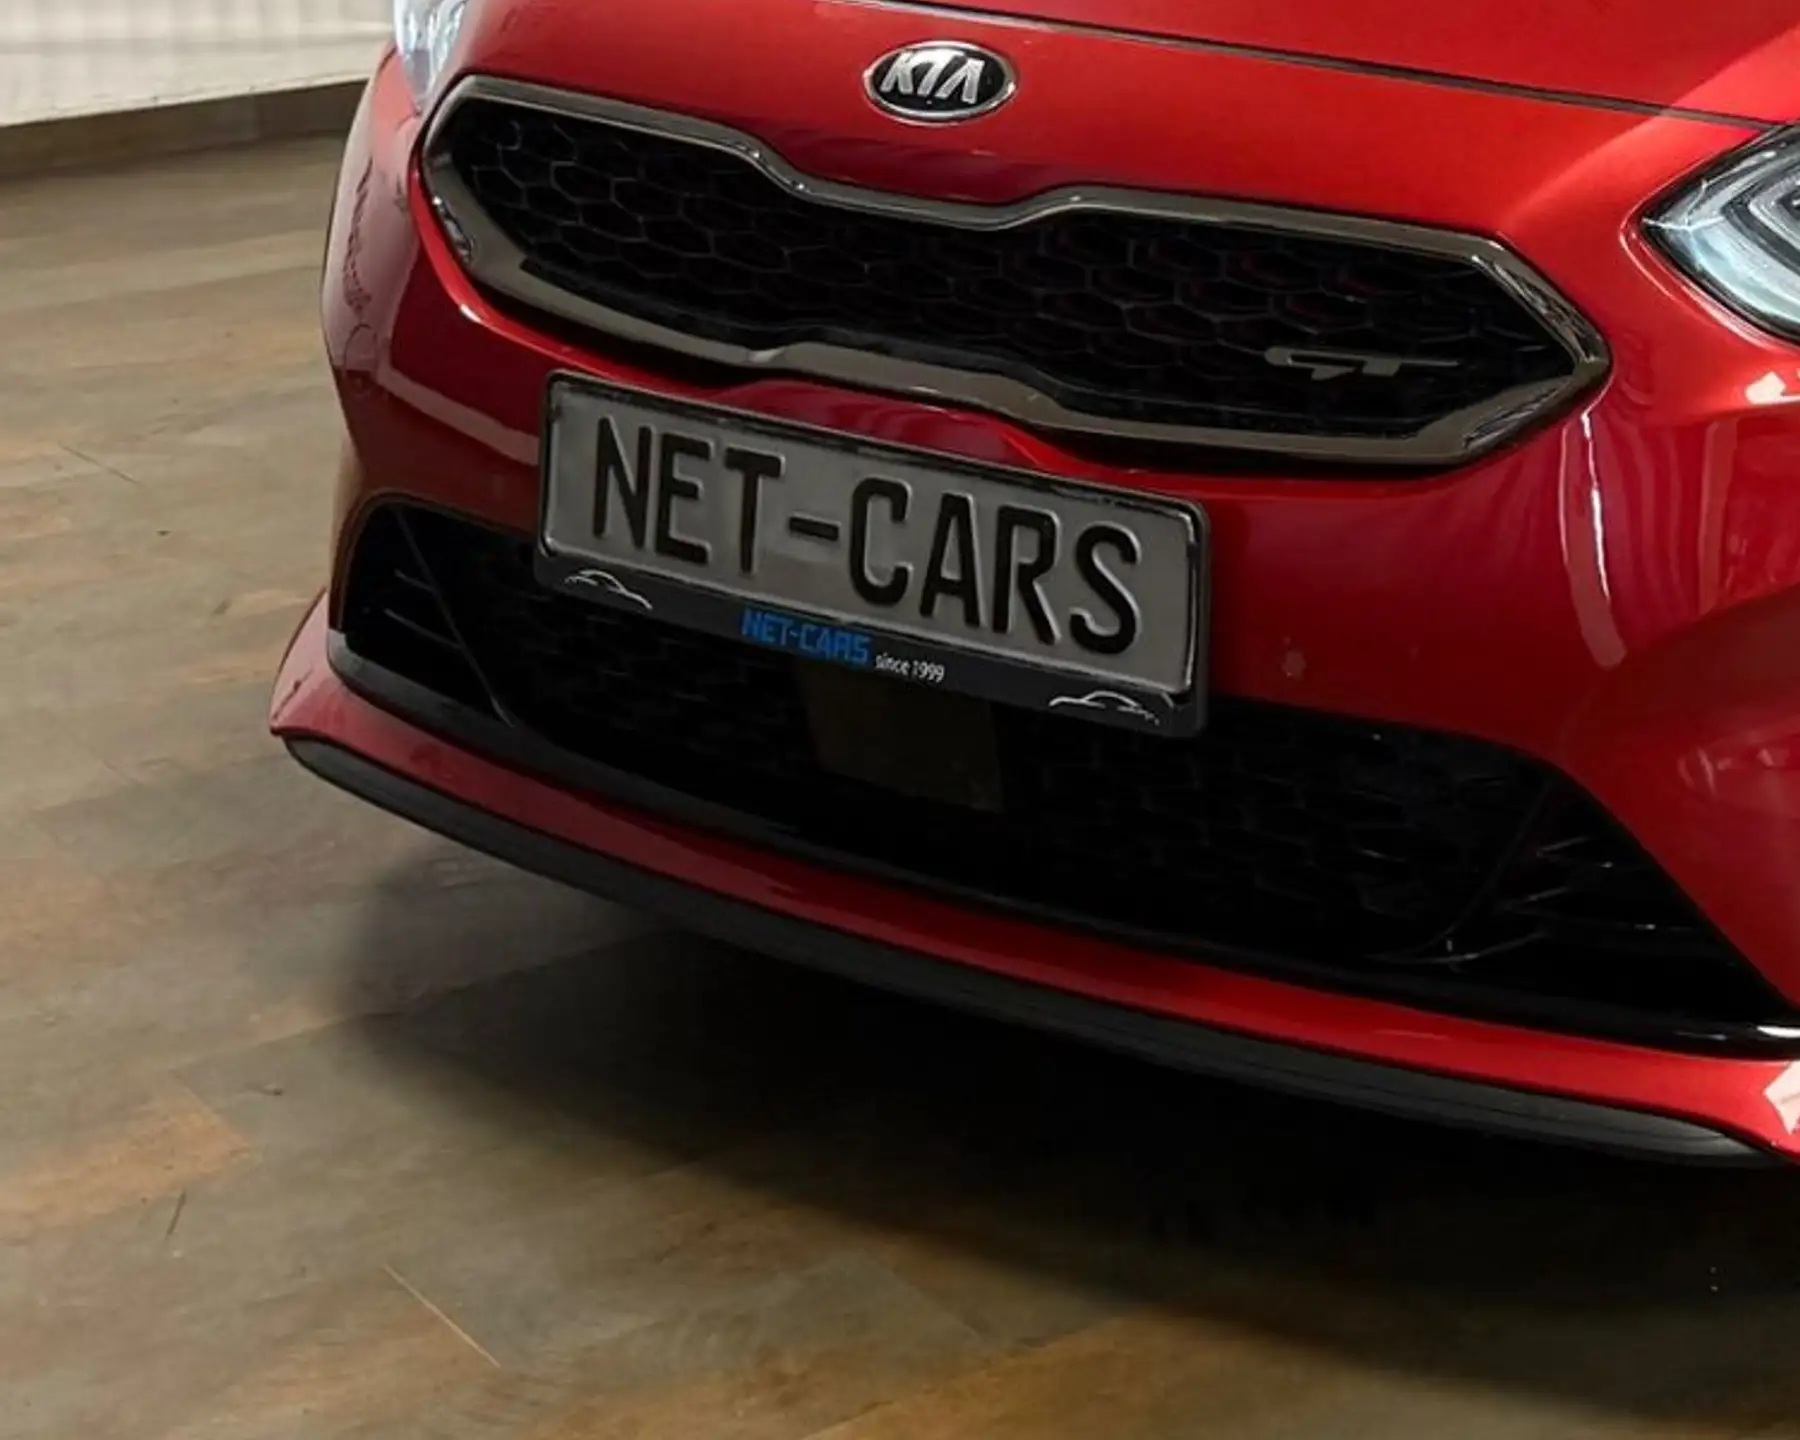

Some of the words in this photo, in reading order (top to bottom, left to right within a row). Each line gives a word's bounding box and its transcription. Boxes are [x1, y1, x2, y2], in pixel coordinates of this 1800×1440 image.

[879, 47, 985, 105] KIA
[592, 415, 1142, 655] NET-CARS
[741, 608, 872, 666] NET-CARS
[875, 651, 911, 676] since
[912, 659, 945, 683] 1999
